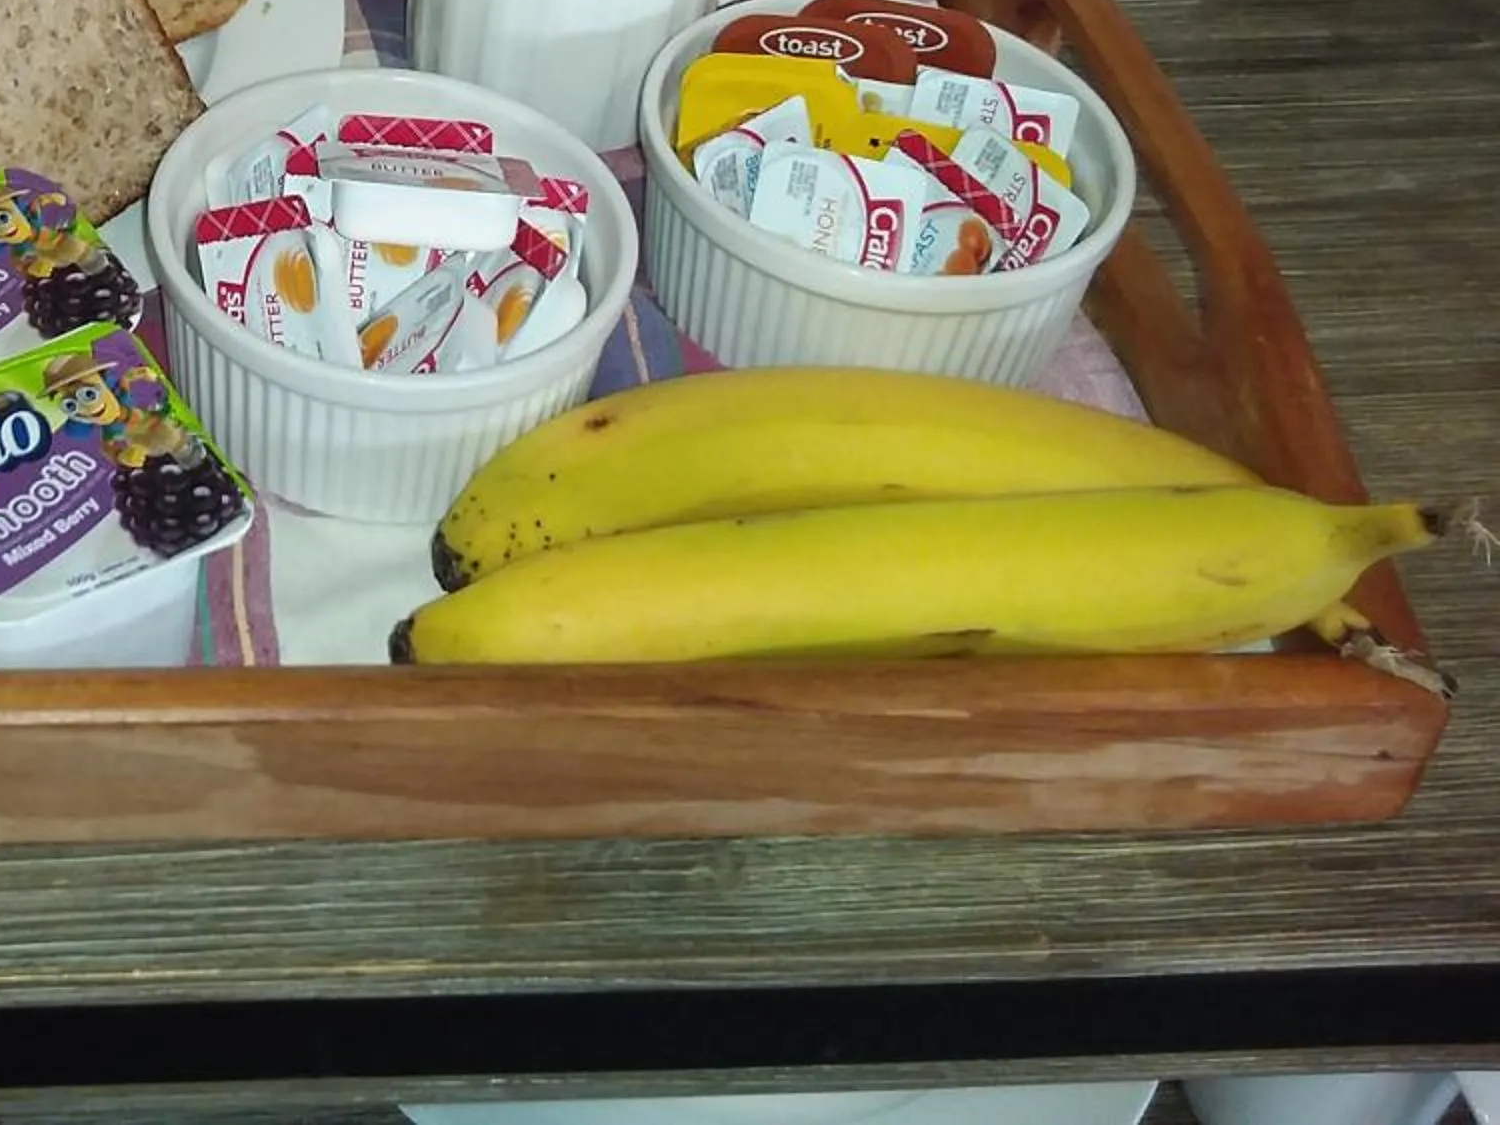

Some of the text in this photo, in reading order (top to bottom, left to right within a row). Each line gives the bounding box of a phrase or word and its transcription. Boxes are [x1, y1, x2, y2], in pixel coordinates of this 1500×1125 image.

[778, 34, 844, 59] toast
[349, 239, 368, 310] BUTTER
[0, 496, 101, 568] Mixed Berry
